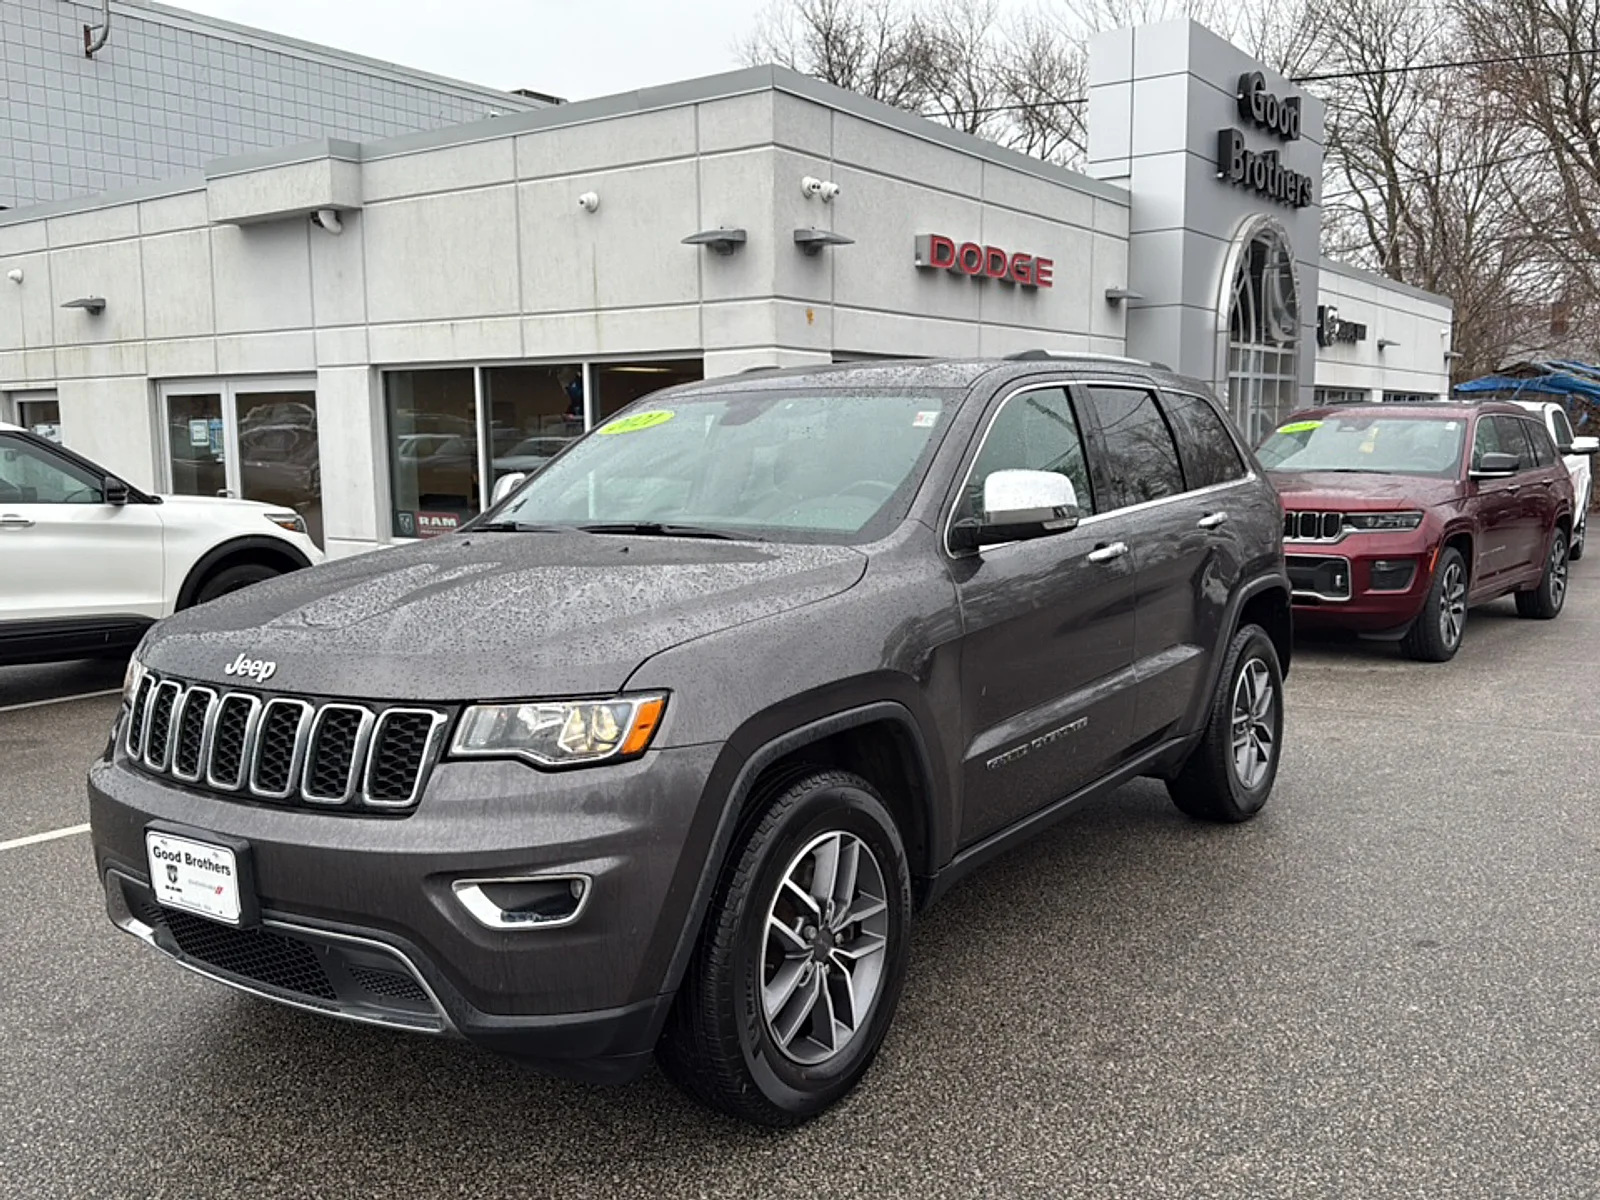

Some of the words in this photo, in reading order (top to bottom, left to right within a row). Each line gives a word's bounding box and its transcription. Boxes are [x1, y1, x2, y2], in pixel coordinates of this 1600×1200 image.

[1239, 71, 1301, 140] Good
[1219, 127, 1312, 208] Brothers
[926, 233, 1054, 288] DODGE
[418, 516, 457, 527] RAM
[224, 653, 277, 683] Jeep
[153, 845, 182, 863] Good
[184, 852, 232, 876] Brothers
